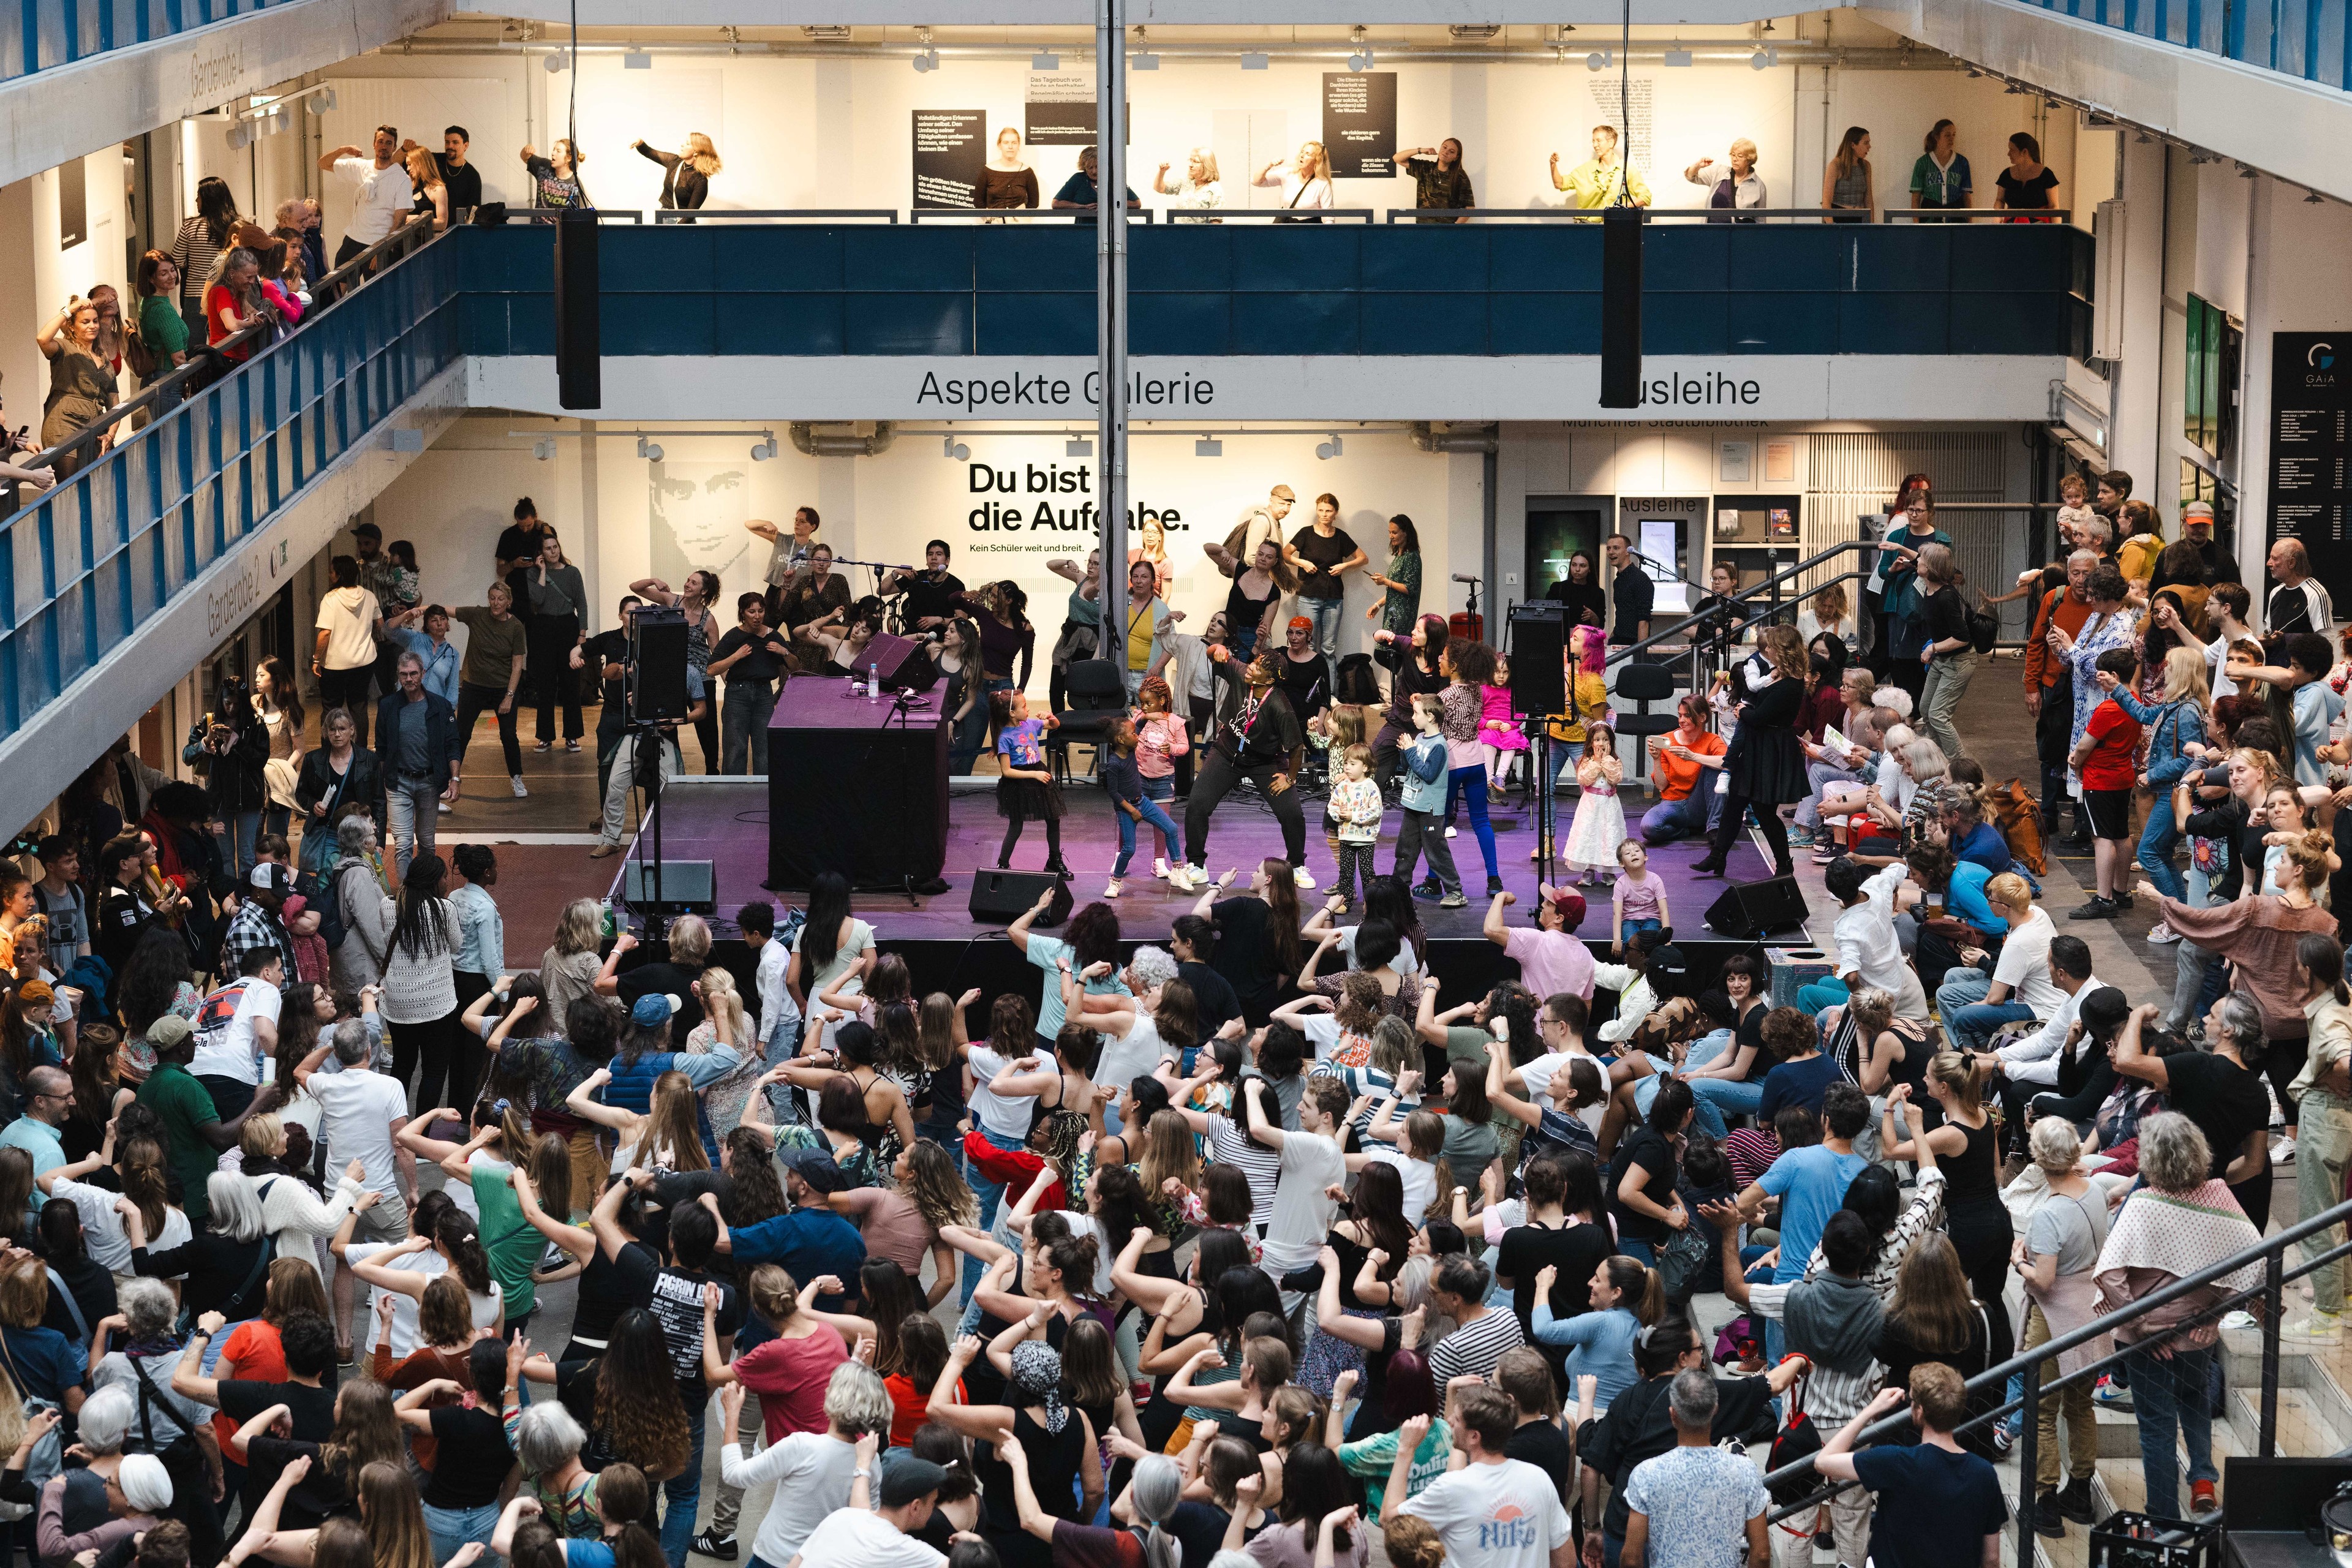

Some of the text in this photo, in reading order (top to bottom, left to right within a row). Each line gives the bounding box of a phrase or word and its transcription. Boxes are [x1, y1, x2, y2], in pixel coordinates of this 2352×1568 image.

[192, 39, 244, 98] Garderobe 4
[918, 187, 947, 197] hinnehmen
[943, 186, 970, 195] Bekanntes
[951, 181, 975, 190] Niederga
[955, 200, 975, 208] bleiben.
[917, 371, 1214, 413] Aspekte Glerie
[1599, 372, 1760, 404] usleihe
[970, 463, 1090, 493] Du bist
[1619, 498, 1697, 512] Ausleihe
[968, 502, 1022, 532] die
[990, 544, 1023, 552] Schüler
[208, 555, 260, 638] Garderobe 2
[1338, 1052, 1367, 1068] VERY
[1351, 1047, 1371, 1061] DAY
[652, 1272, 696, 1297] FIGRIN
[665, 1311, 680, 1320] PALACE
[1479, 1518, 1536, 1552] Nike
